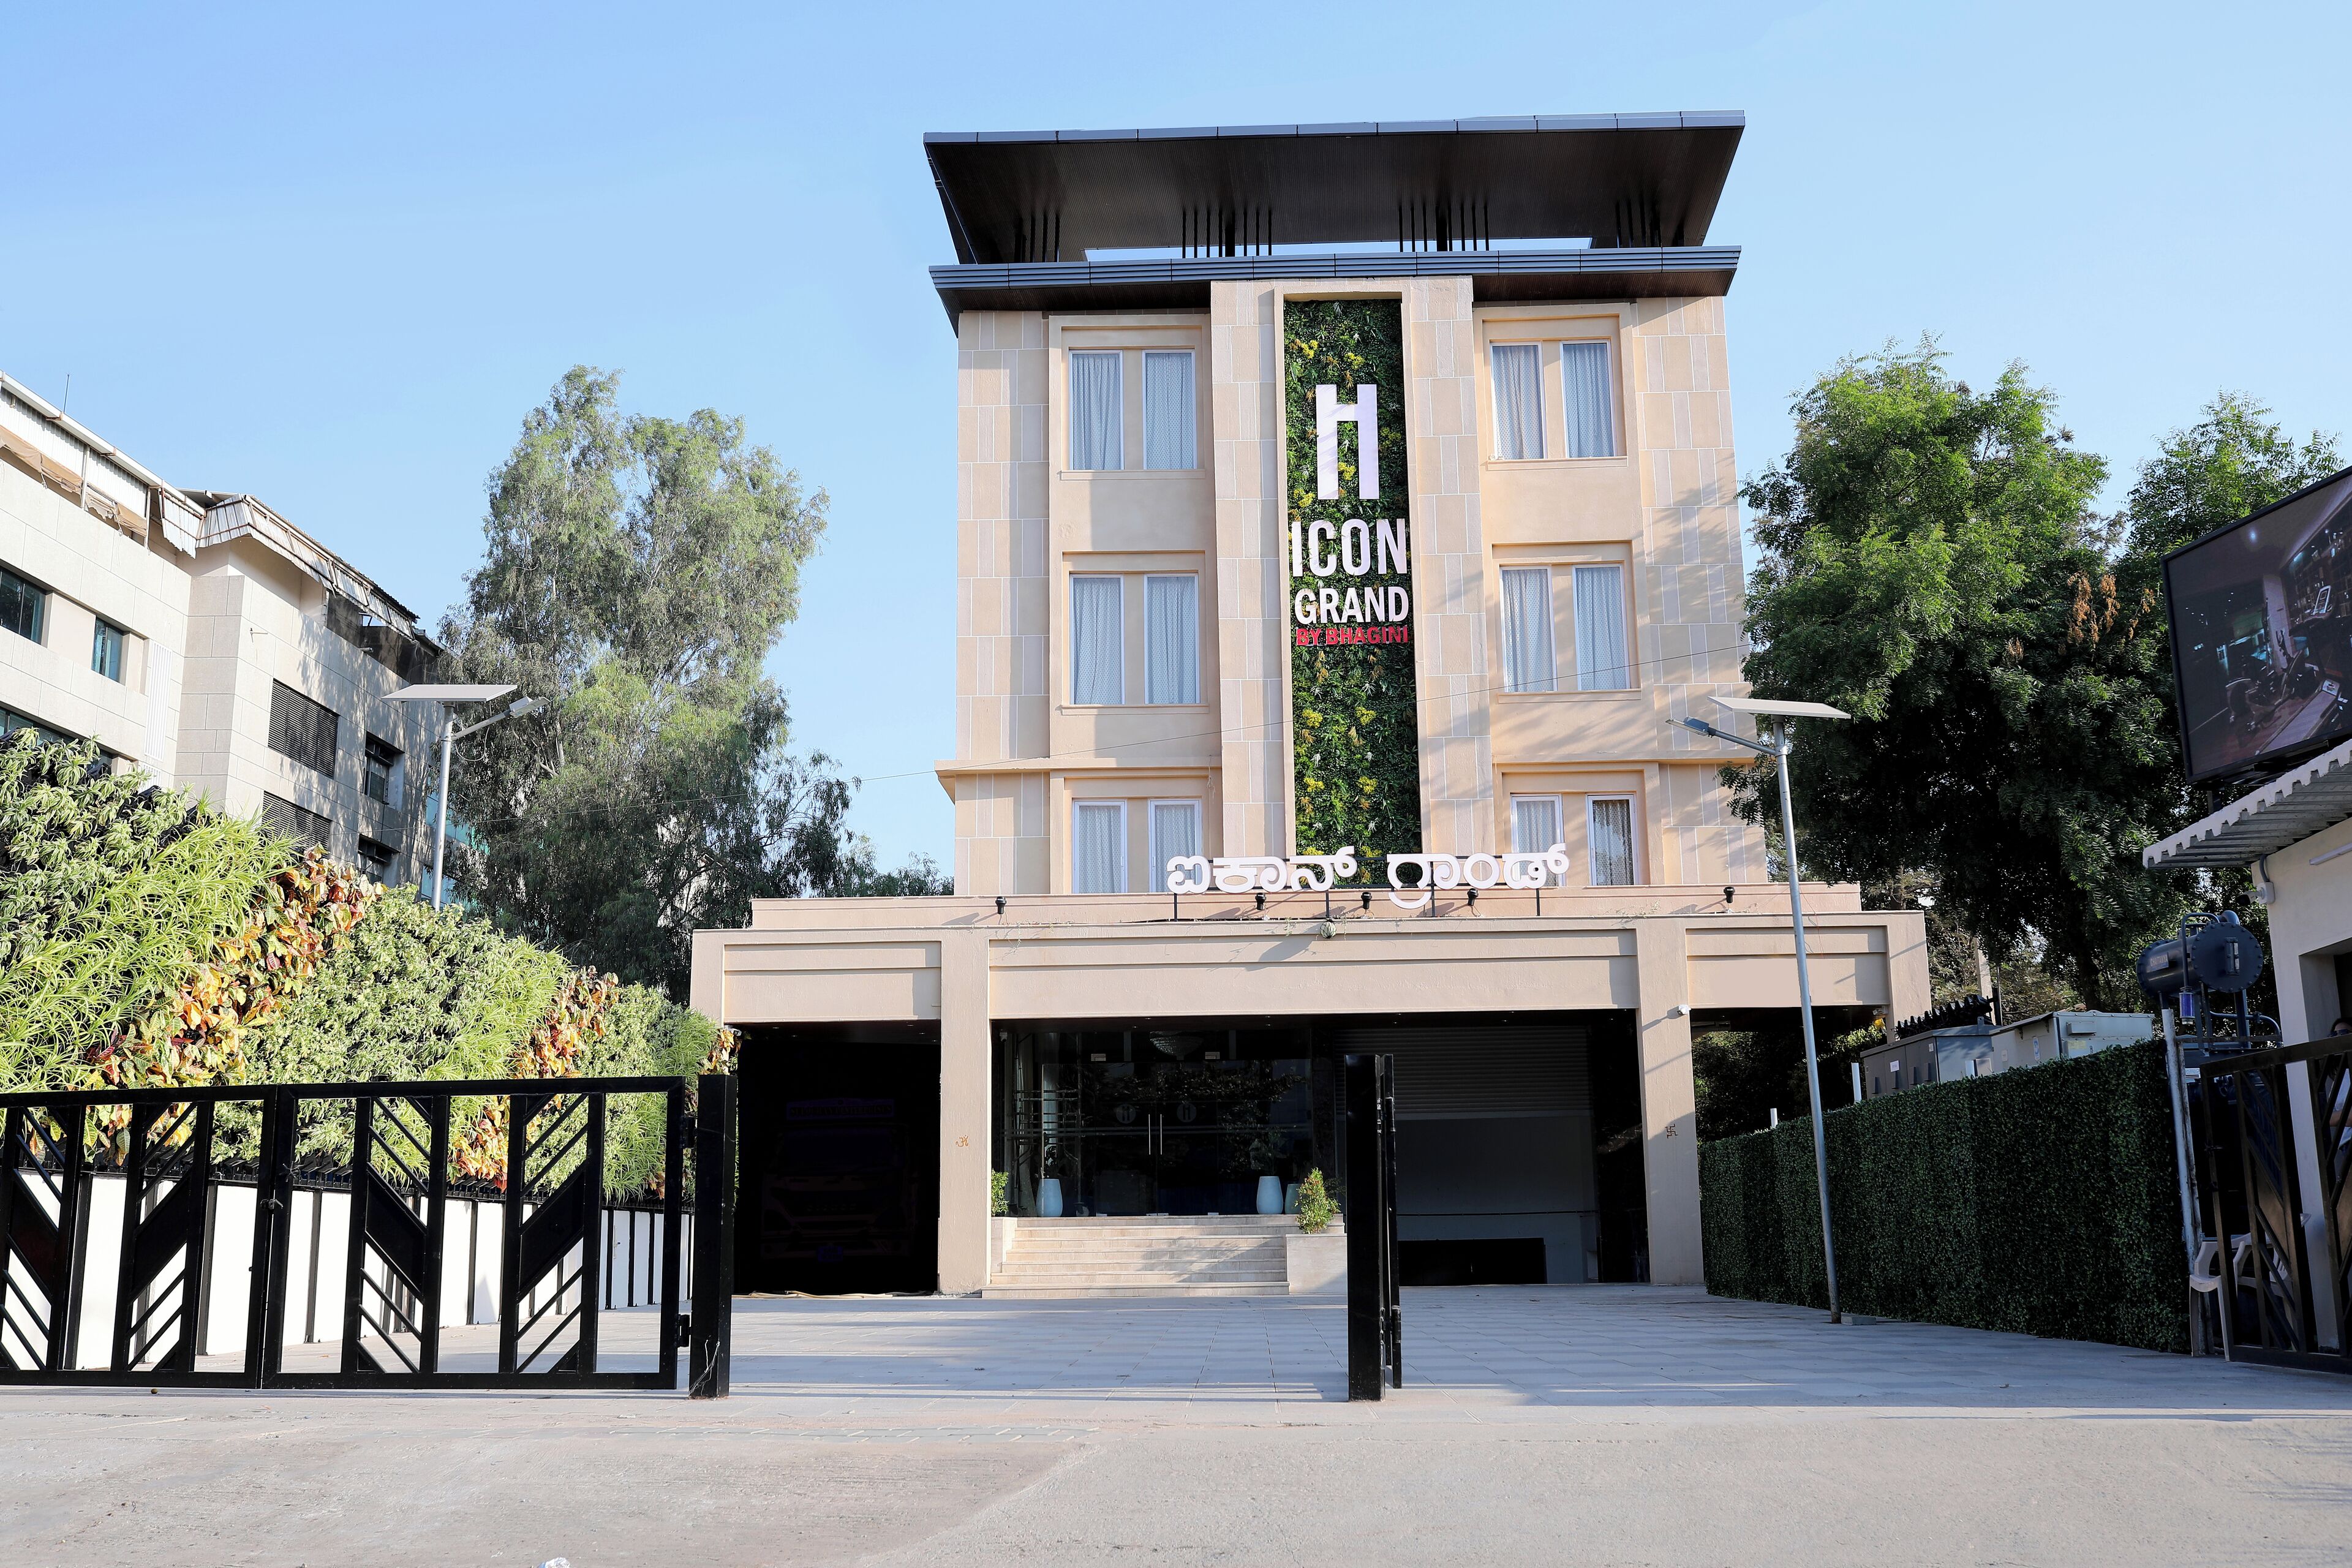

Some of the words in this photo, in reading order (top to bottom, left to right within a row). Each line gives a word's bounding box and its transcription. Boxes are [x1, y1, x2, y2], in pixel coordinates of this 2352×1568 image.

[1316, 384, 1379, 500] H
[1291, 519, 1407, 577] ICON
[1294, 587, 1408, 624] GRAND
[1296, 628, 1321, 646] BY
[1325, 625, 1408, 645] BHAGINI
[1167, 846, 1357, 894] ಐಕಾನ್
[1387, 843, 1570, 910] ಗ್ರಾಂಡ್
